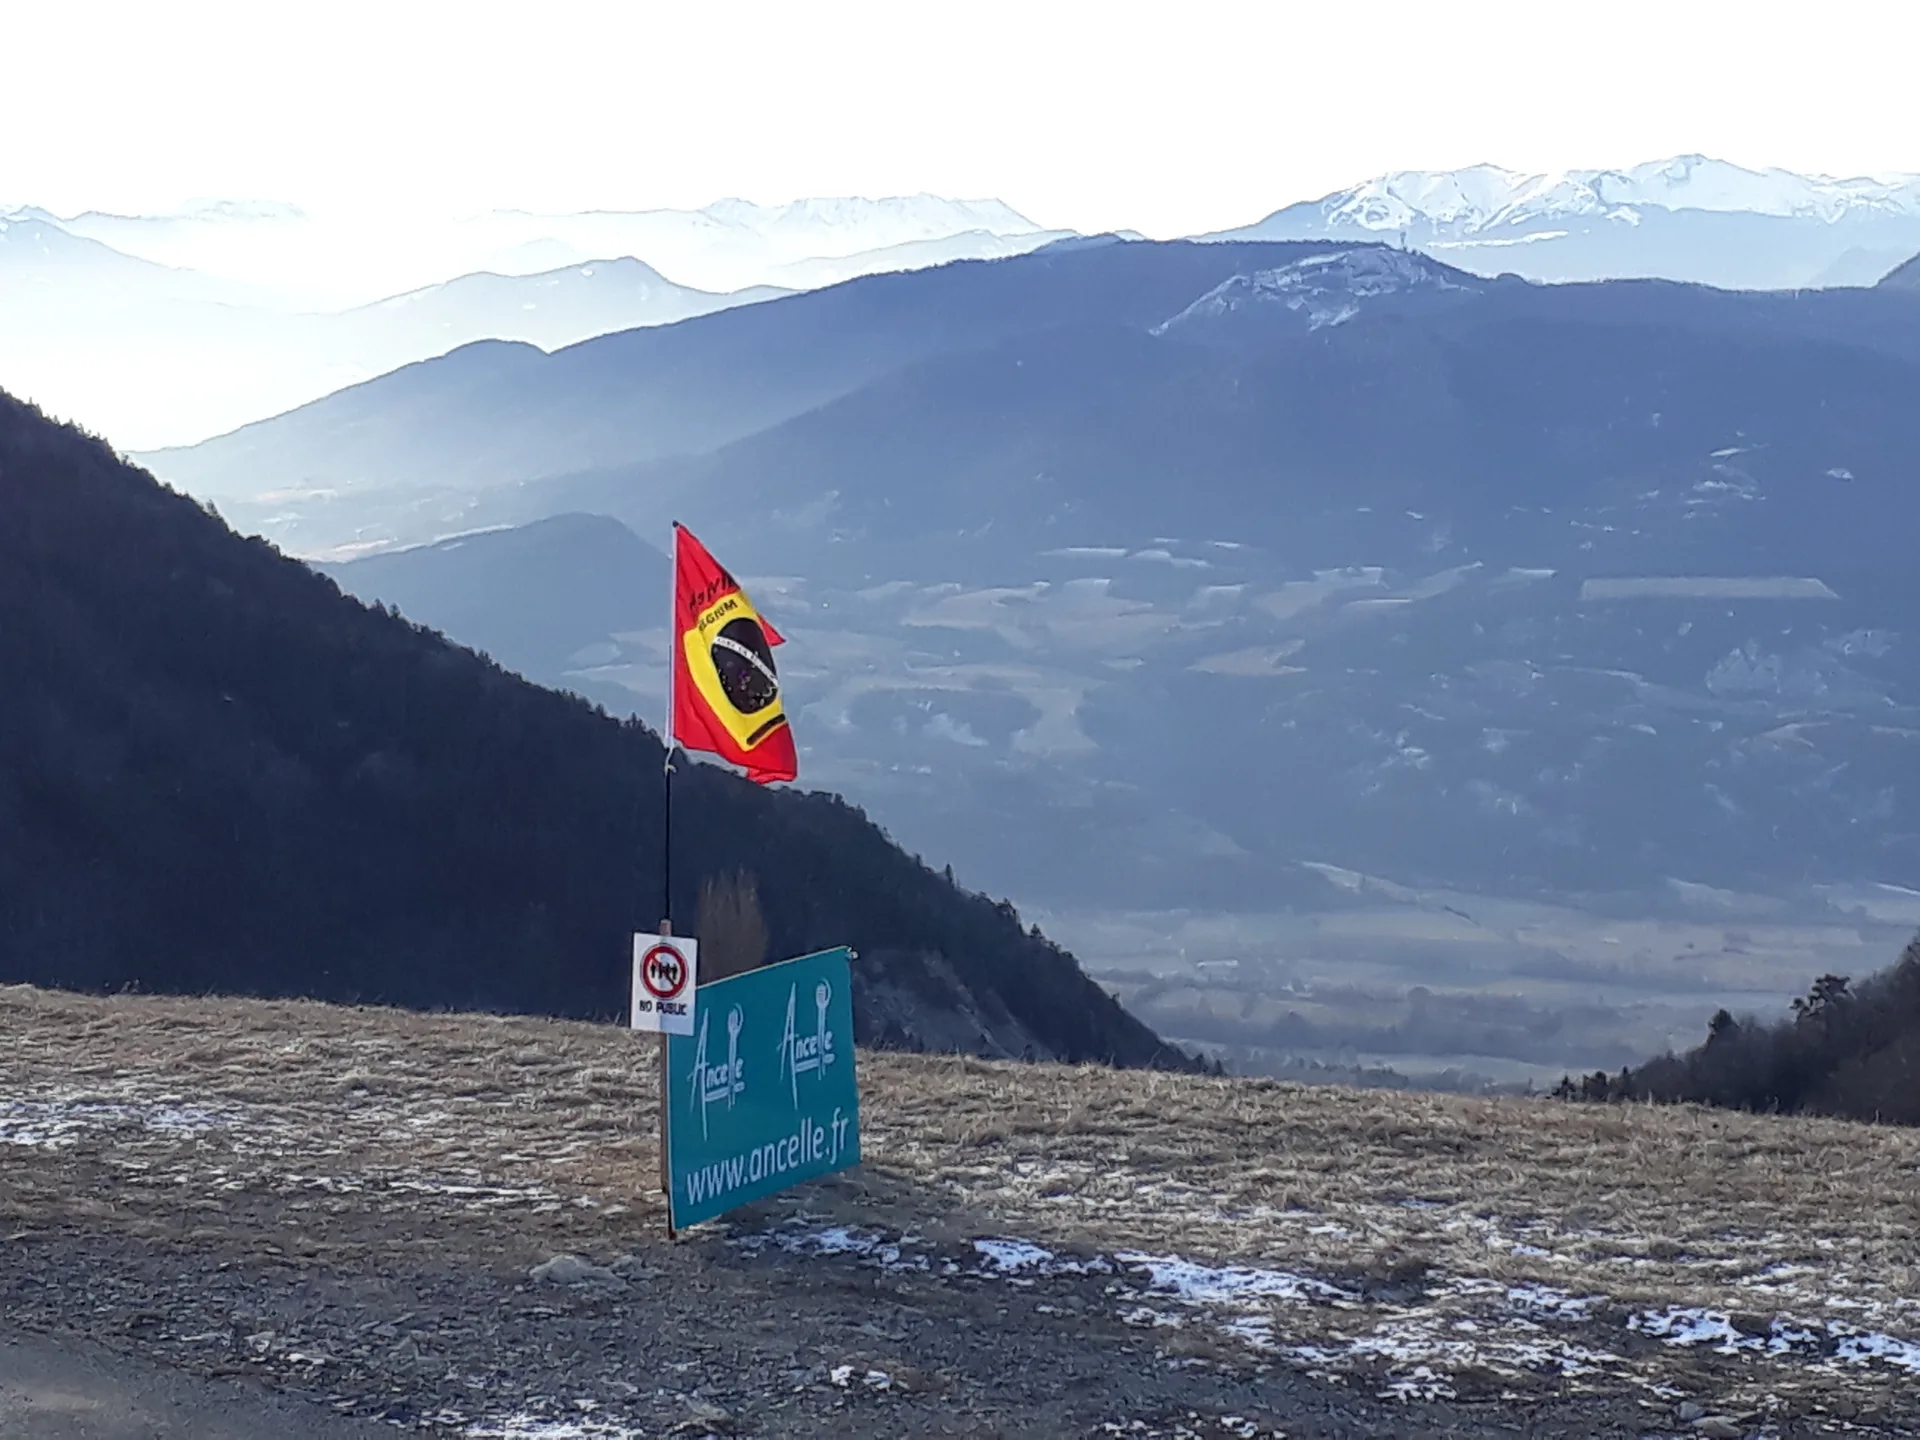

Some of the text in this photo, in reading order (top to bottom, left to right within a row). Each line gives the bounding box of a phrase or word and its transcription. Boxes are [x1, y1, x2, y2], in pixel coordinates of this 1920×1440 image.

[639, 1000, 687, 1016] NO PUBLIC
[776, 978, 836, 1110] Ancelle
[686, 1003, 745, 1141] Ancelle
[687, 1106, 849, 1205] www.ancelle.fr
